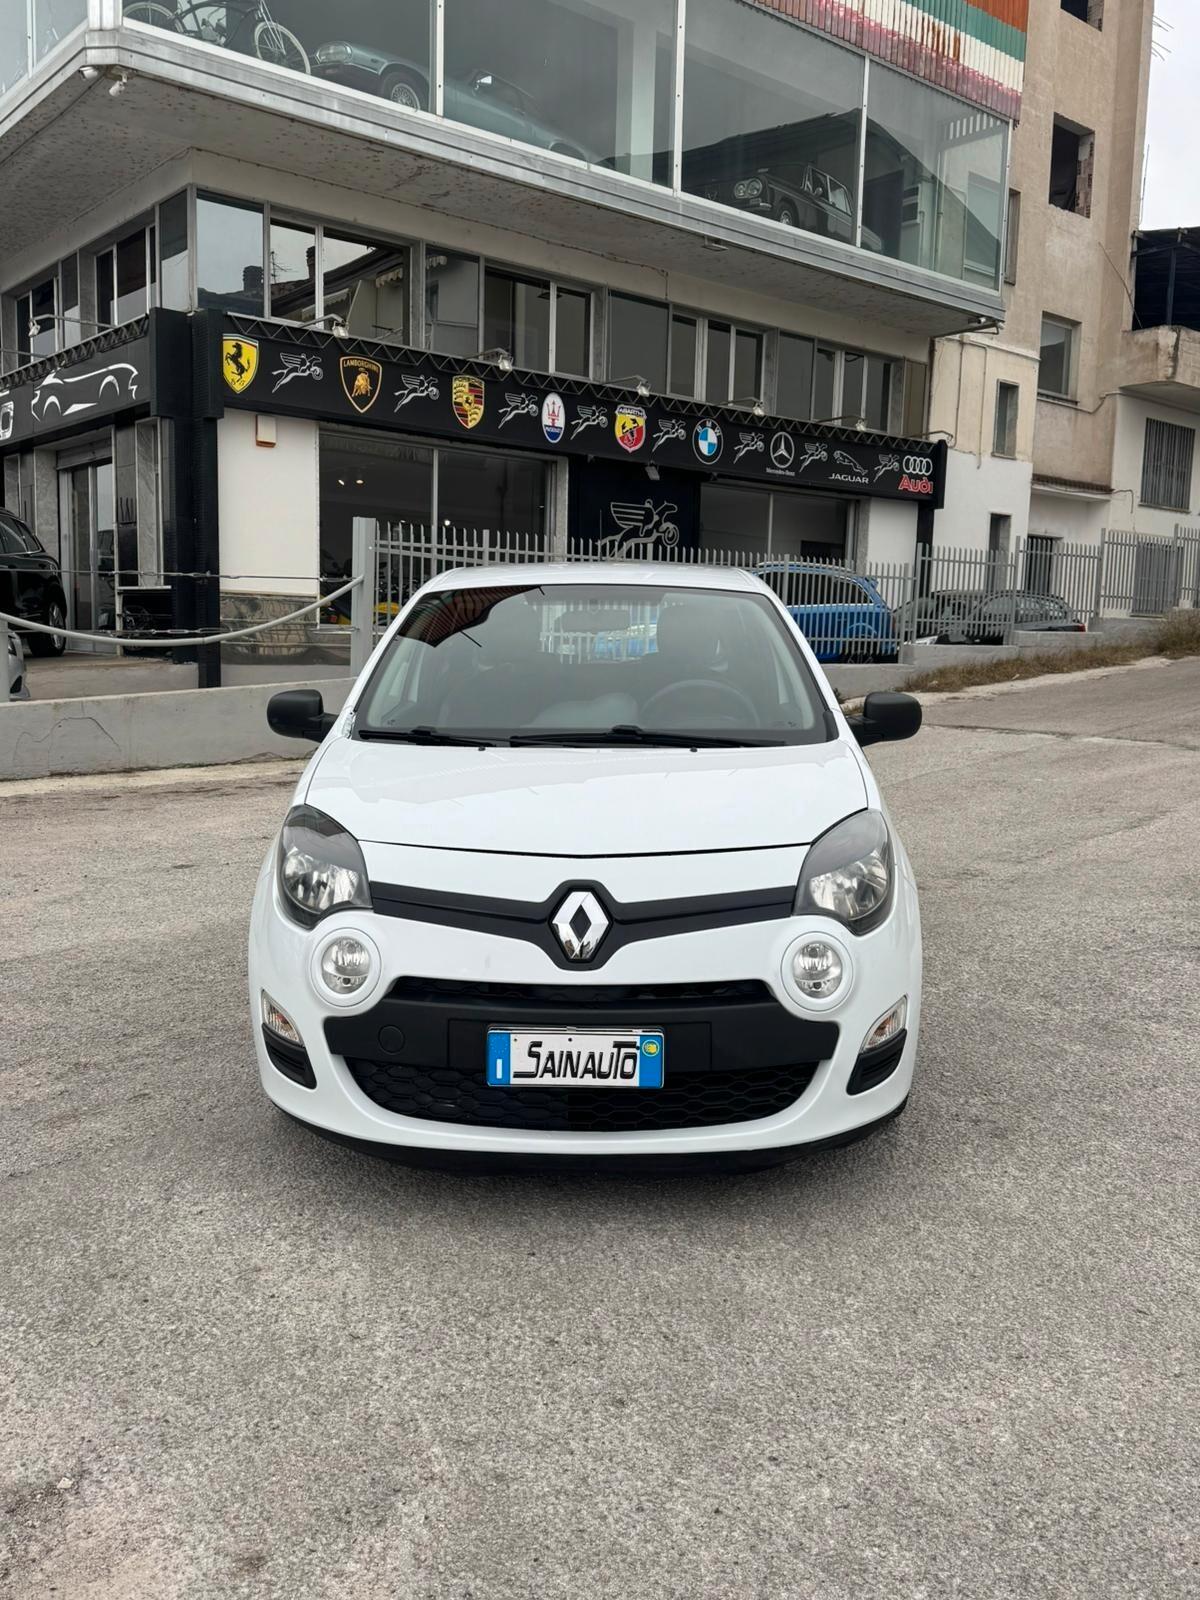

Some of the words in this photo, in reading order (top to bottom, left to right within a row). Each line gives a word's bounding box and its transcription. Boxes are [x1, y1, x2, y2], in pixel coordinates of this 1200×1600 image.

[696, 419, 721, 436] BMW
[828, 473, 869, 484] JAGUAR
[898, 474, 933, 494] Audi
